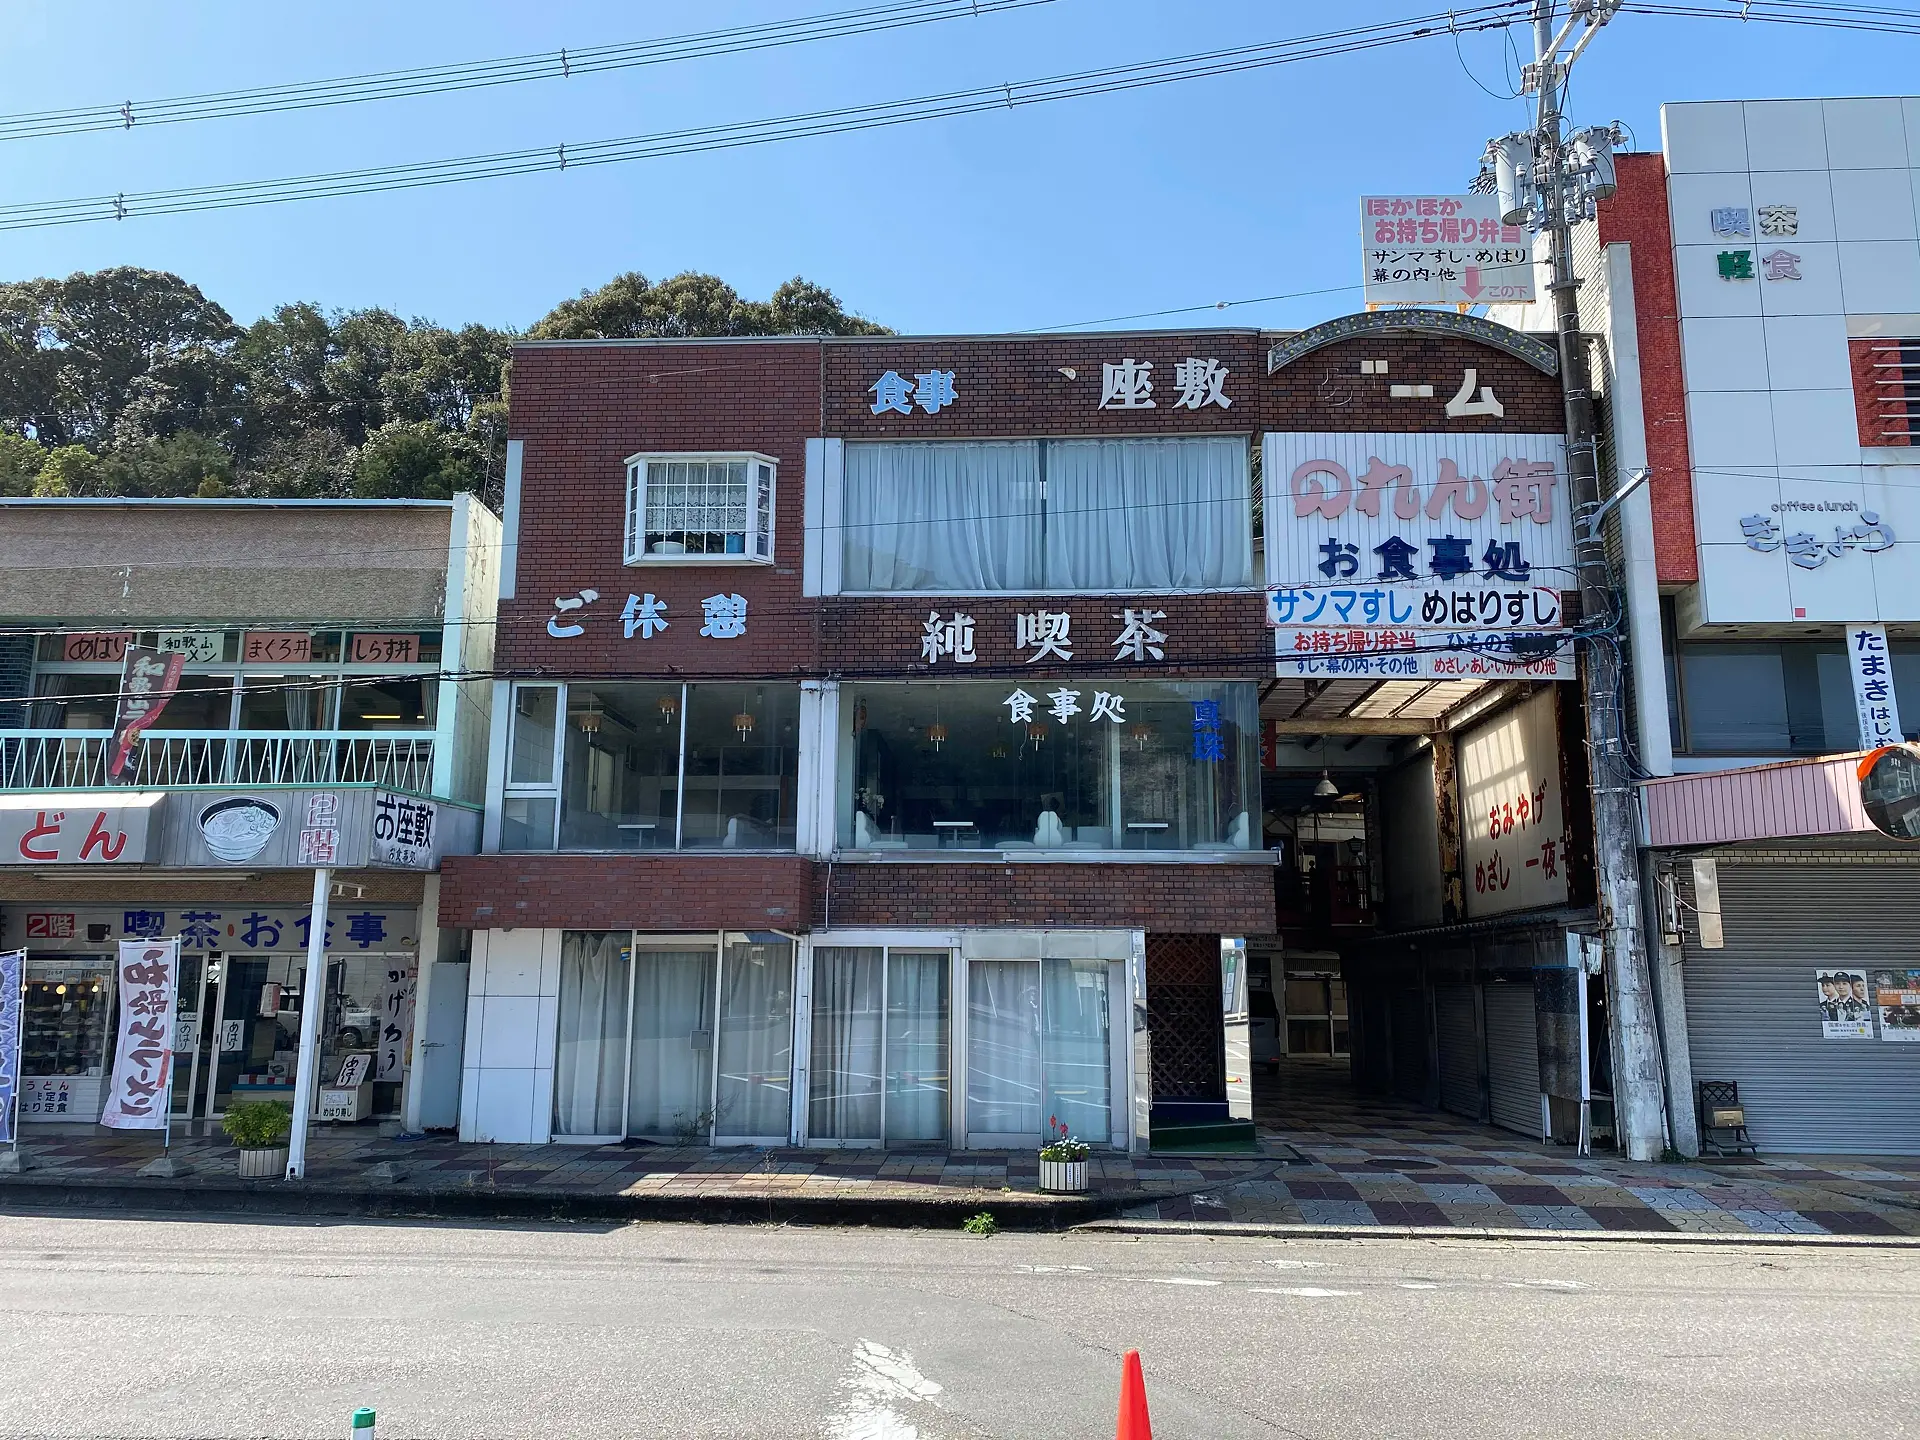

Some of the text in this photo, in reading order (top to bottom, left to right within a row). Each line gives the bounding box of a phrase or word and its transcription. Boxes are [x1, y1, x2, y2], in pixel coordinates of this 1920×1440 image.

[1367, 198, 1462, 216] ほかほか
[1711, 204, 1799, 237] 喫茶
[1375, 218, 1521, 244] お持ち帰り弁当
[1372, 249, 1527, 264] サンマすし・めはり
[1716, 249, 1802, 281] 軽食
[1489, 286, 1528, 298] この下
[868, 370, 958, 416] 食事
[1291, 456, 1557, 524] のれん街
[1318, 534, 1530, 581] お食事処
[547, 589, 748, 639] ご休憩
[1273, 589, 1557, 624] サンマすし めはりすし
[68, 636, 129, 661] めはり
[164, 636, 213, 650] 和歌山
[249, 639, 308, 660] まぐろ丼
[356, 639, 412, 662] しらす丼
[921, 609, 1169, 664] 純喫茶
[1294, 631, 1416, 652] お持ち帰り弁当
[1002, 687, 1127, 724] 食事処
[1191, 700, 1225, 762] 真珠
[374, 794, 433, 849] お座敷
[1490, 778, 1547, 840] おみやげ
[19, 811, 128, 862] どん
[1475, 849, 1510, 894] めざし
[29, 915, 72, 938] 2階
[179, 1023, 191, 1051] めはり
[227, 1022, 238, 1050] めはり
[386, 970, 407, 1072] かげろう
[26, 1081, 69, 1091] うどん
